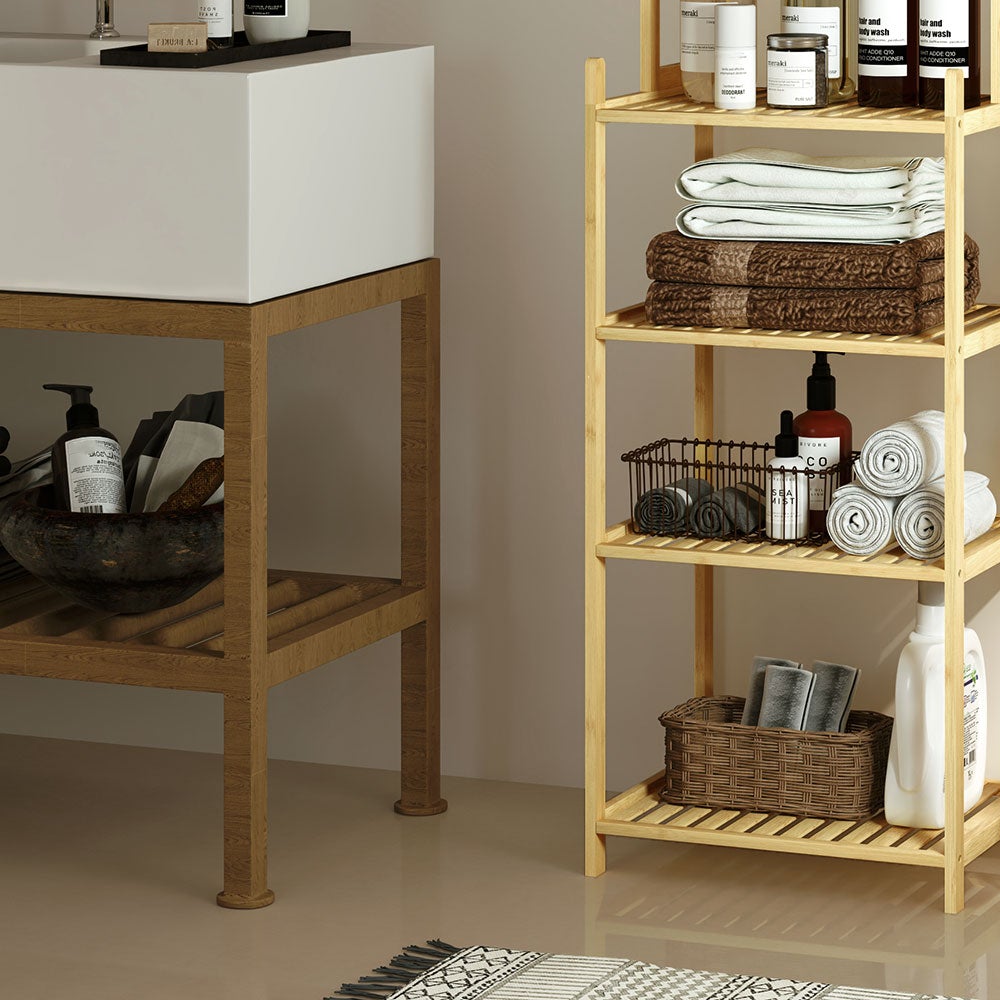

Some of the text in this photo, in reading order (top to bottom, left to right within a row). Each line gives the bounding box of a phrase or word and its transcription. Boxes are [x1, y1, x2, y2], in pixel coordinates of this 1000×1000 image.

[868, 17, 881, 26] and
[871, 28, 890, 36] wash
[932, 30, 952, 38] wash
